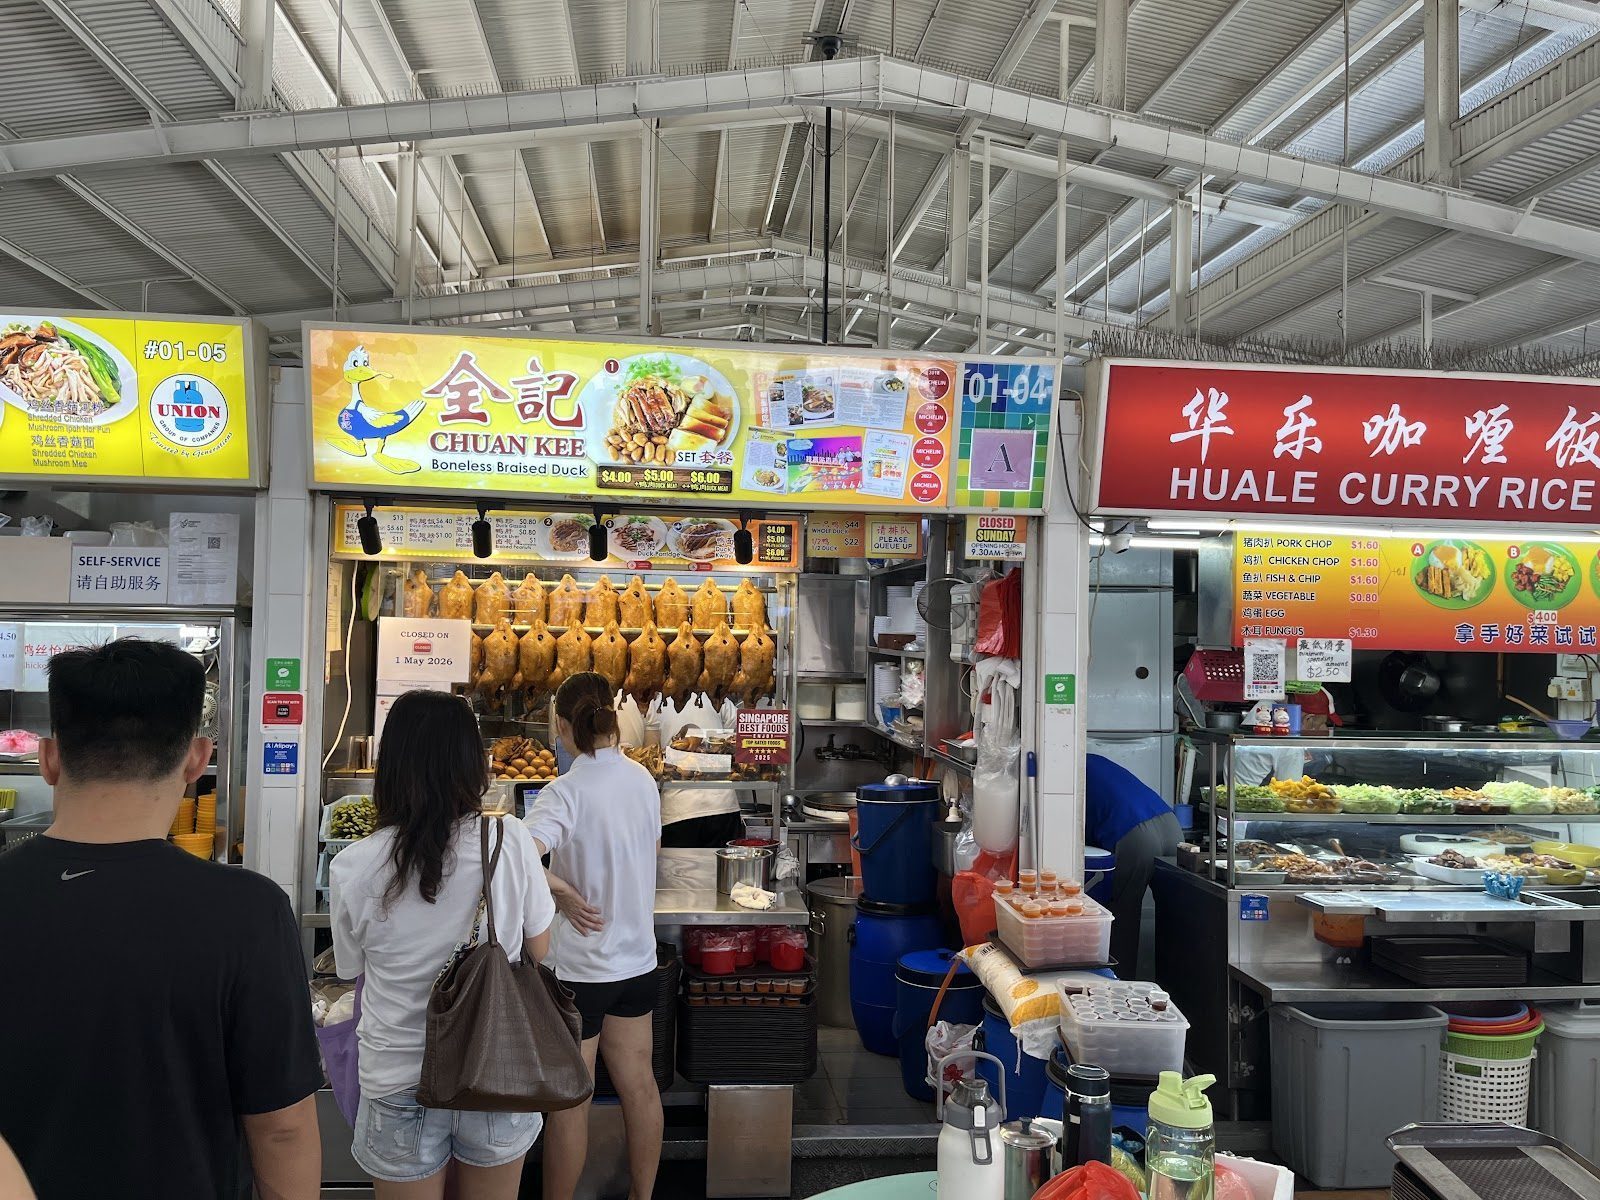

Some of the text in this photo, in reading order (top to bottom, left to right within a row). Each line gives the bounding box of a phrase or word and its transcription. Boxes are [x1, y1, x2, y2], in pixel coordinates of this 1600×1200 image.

[144, 340, 227, 362] #01-05
[422, 351, 586, 429] 全記
[968, 372, 1048, 406] 01-04
[156, 403, 222, 419] UNION
[159, 419, 177, 438] GROUP
[191, 421, 221, 443] COMPANIES
[1169, 386, 1600, 466] 华乐咖喱饭
[430, 431, 586, 458] CHUAN KEE
[677, 450, 733, 465] SET 套餐
[985, 443, 1016, 473] A
[431, 459, 588, 477] Boneless Braised Duck
[602, 469, 721, 484] $4.00 $5.00 $6.00
[1169, 467, 1597, 512] HUALE CURRY RICE
[979, 517, 1014, 528] CLOSED
[977, 529, 1015, 542] SUNDAY
[1243, 537, 1379, 550] 猪肉扒 PORK CHOP $1.60
[78, 556, 161, 567] SELF-SERVICE
[1243, 555, 1378, 567] 鸡扒 CHICKEN CHOP $1.60
[76, 574, 162, 591] 请自助服务
[1242, 573, 1378, 585] 鱼扒 FISH & CHIP $1.60
[1242, 590, 1378, 602] 蔬菜 VEGETABLE $0.80
[1242, 608, 1285, 618] 鸡蛋 EGG
[1241, 625, 1377, 637] 木耳 FUNGUS $1.30
[1455, 623, 1596, 645] 拿手好菜试试
[395, 656, 453, 666] 1 May 2026
[1306, 665, 1340, 679] $2.50
[739, 713, 789, 724] SINGAPORE
[740, 723, 787, 733] BEST FOODS
